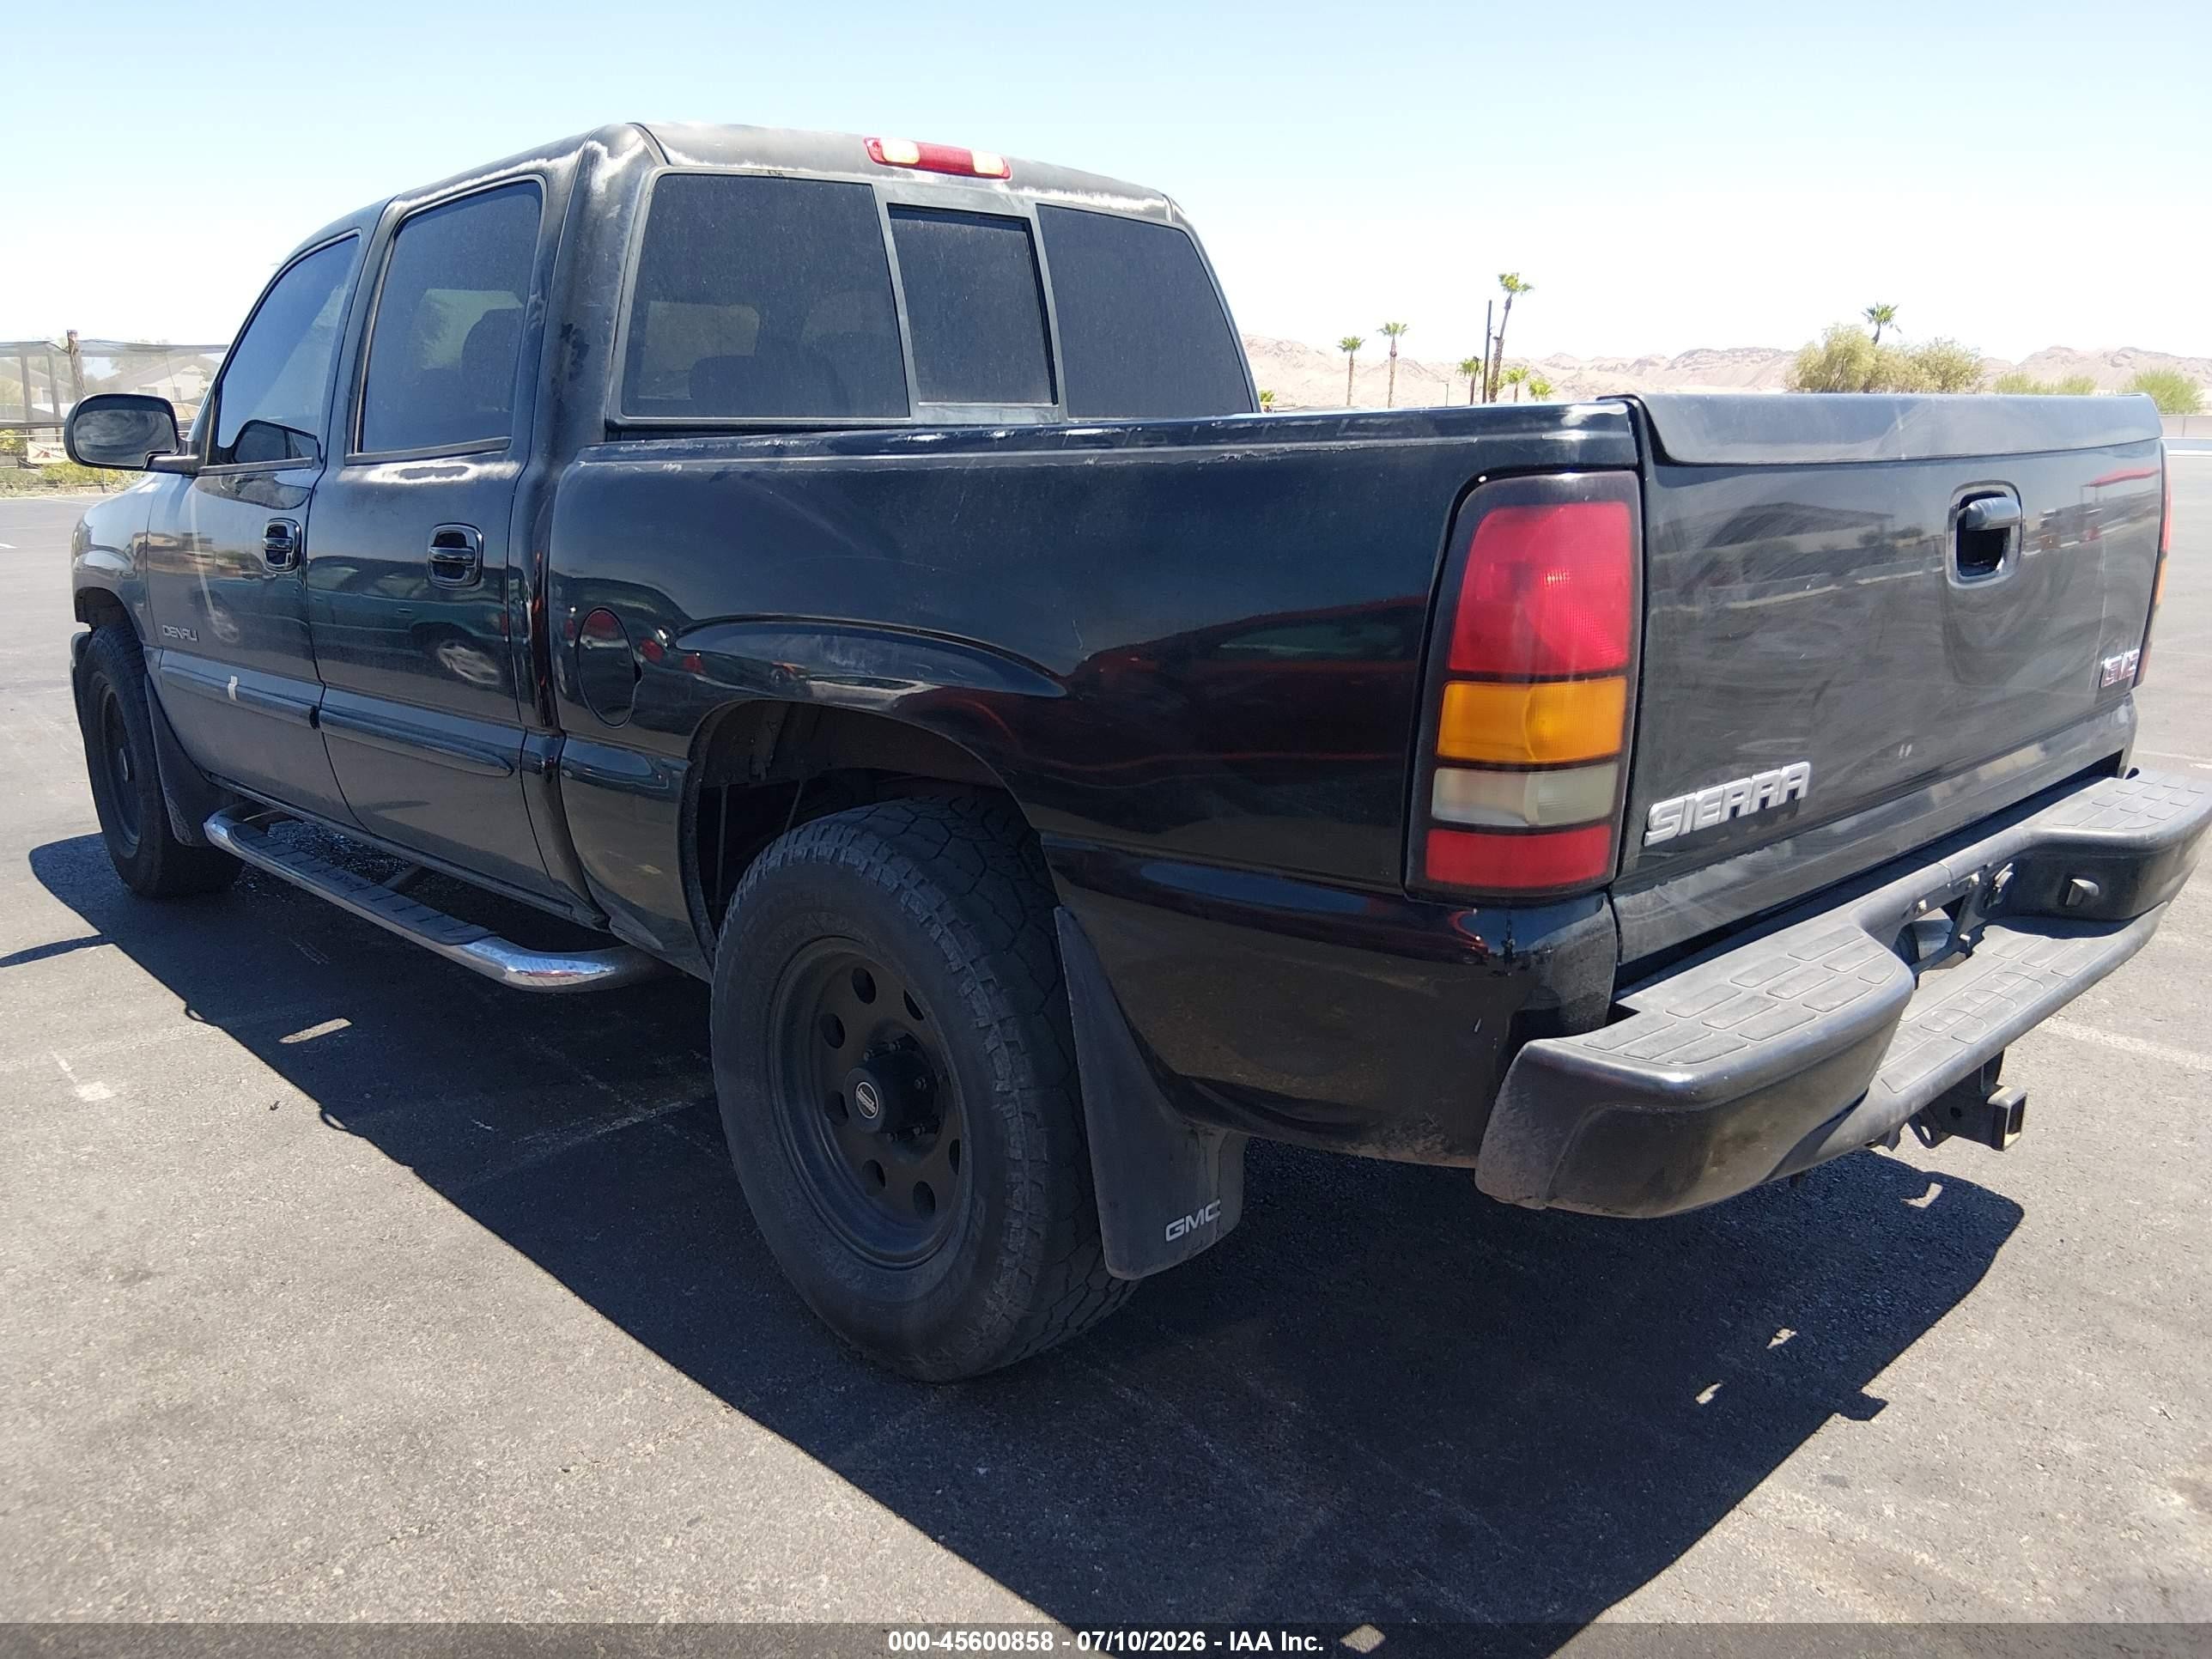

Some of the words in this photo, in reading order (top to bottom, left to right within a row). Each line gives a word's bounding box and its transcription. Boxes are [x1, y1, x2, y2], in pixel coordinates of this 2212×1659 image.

[162, 625, 198, 645] DENALI
[2100, 648, 2140, 687] GMC
[1644, 762, 1810, 847] SIERRA
[1165, 1199, 1221, 1242] GMC
